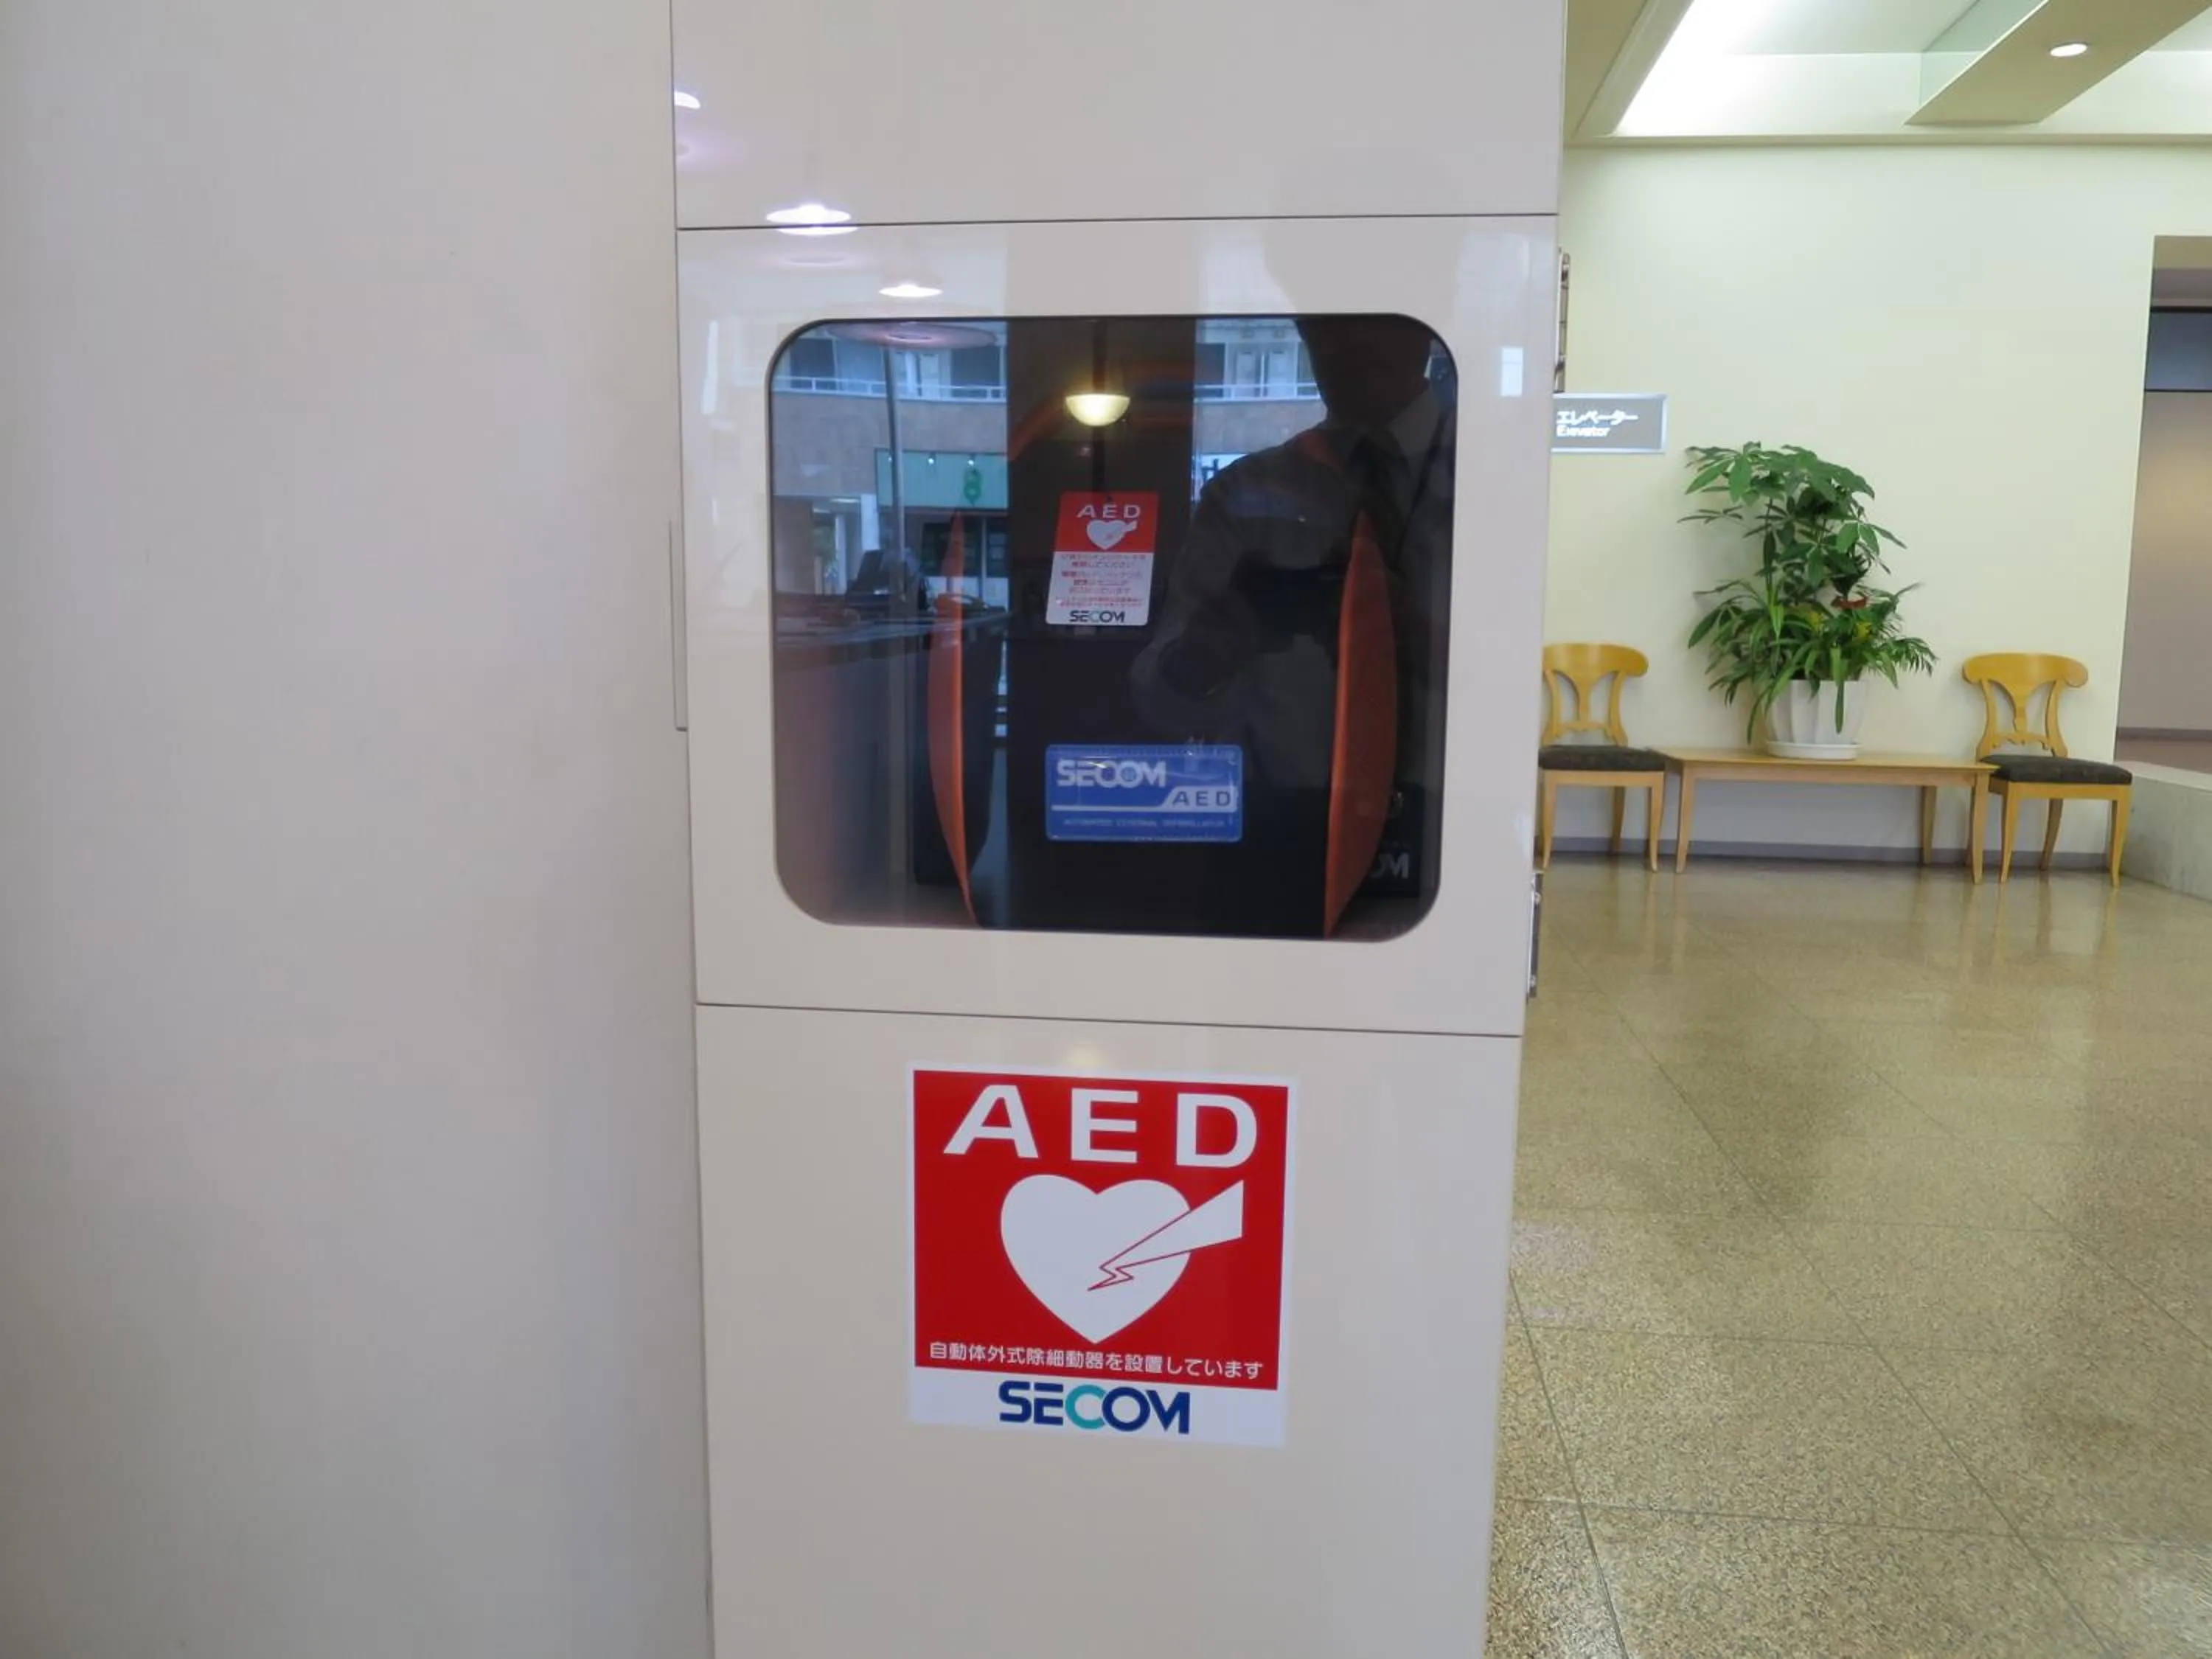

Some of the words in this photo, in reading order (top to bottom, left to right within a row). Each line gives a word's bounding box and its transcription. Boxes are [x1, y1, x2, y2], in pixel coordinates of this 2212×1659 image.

[1556, 410, 1639, 425] エレベーター
[1557, 424, 1610, 437] Elevator
[1076, 504, 1141, 518] AED
[1068, 610, 1126, 623] SECOM
[1056, 758, 1166, 788] SECOM
[1172, 790, 1232, 807] AED
[943, 1084, 1258, 1168] AED
[929, 1341, 1263, 1380] 自動体外式除細動器を設置しています
[998, 1380, 1191, 1434] SECOM
